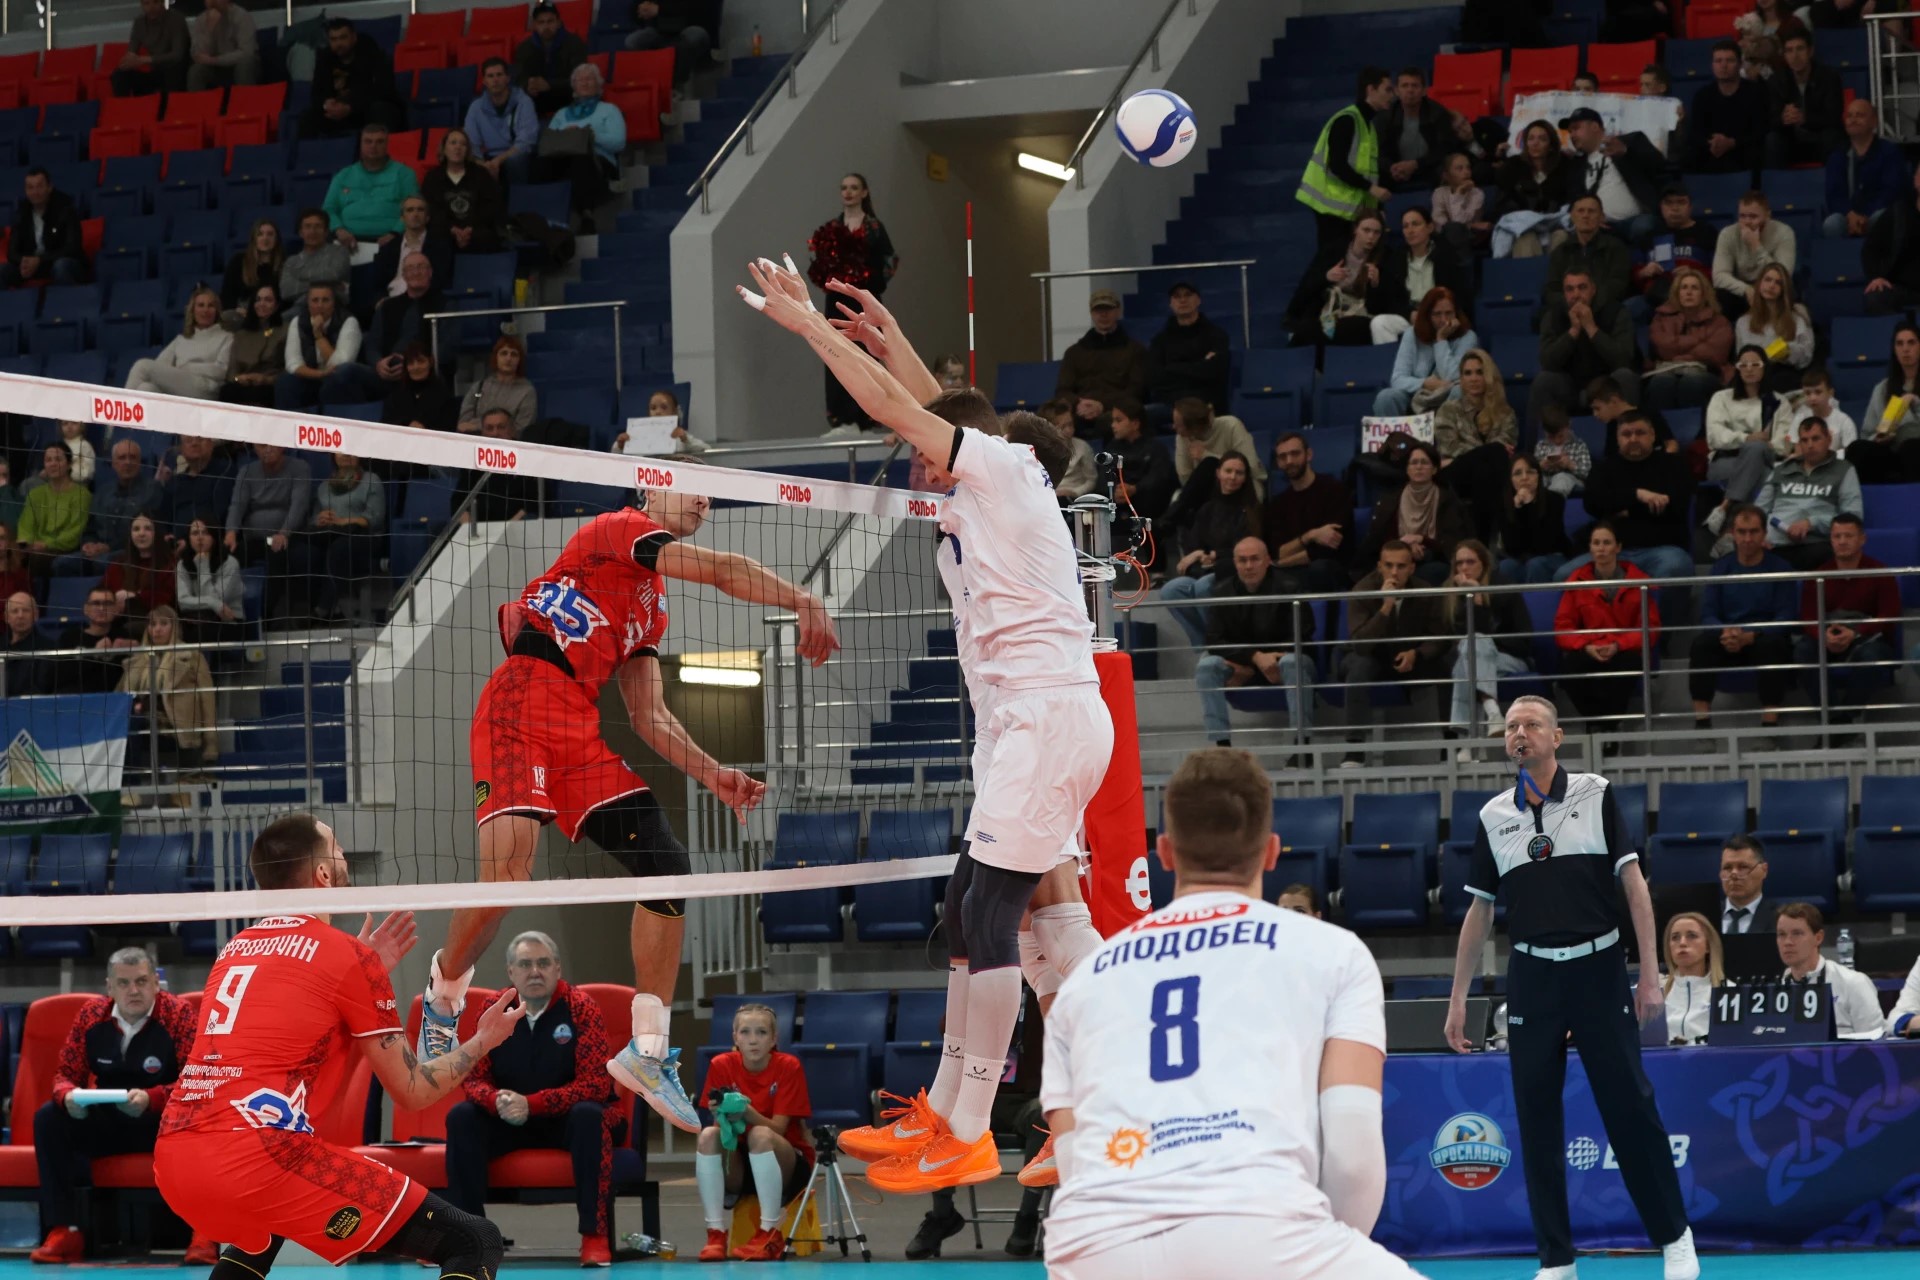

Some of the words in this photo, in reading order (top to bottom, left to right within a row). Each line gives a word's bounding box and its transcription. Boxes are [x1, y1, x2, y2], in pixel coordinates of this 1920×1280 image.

[94, 398, 144, 423] РОЛЬФ
[298, 426, 342, 448] РОЛЬФ
[478, 448, 516, 469] РОЛЬФ
[637, 467, 673, 487] РОЛЬФ
[780, 484, 812, 503] РОЛЬФ
[908, 500, 937, 517] РОЛЬФ
[532, 766, 545, 789] 18
[1093, 921, 1278, 974] СПОДОБЕЦ
[204, 965, 258, 1035] 9
[1718, 993, 1741, 1022] 11
[1751, 992, 1765, 1014] 2
[1775, 991, 1789, 1013] 0
[1803, 989, 1818, 1019] 9
[1149, 975, 1201, 1083] 8
[1432, 1143, 1509, 1165] ЯРОСЛАВИЧ
